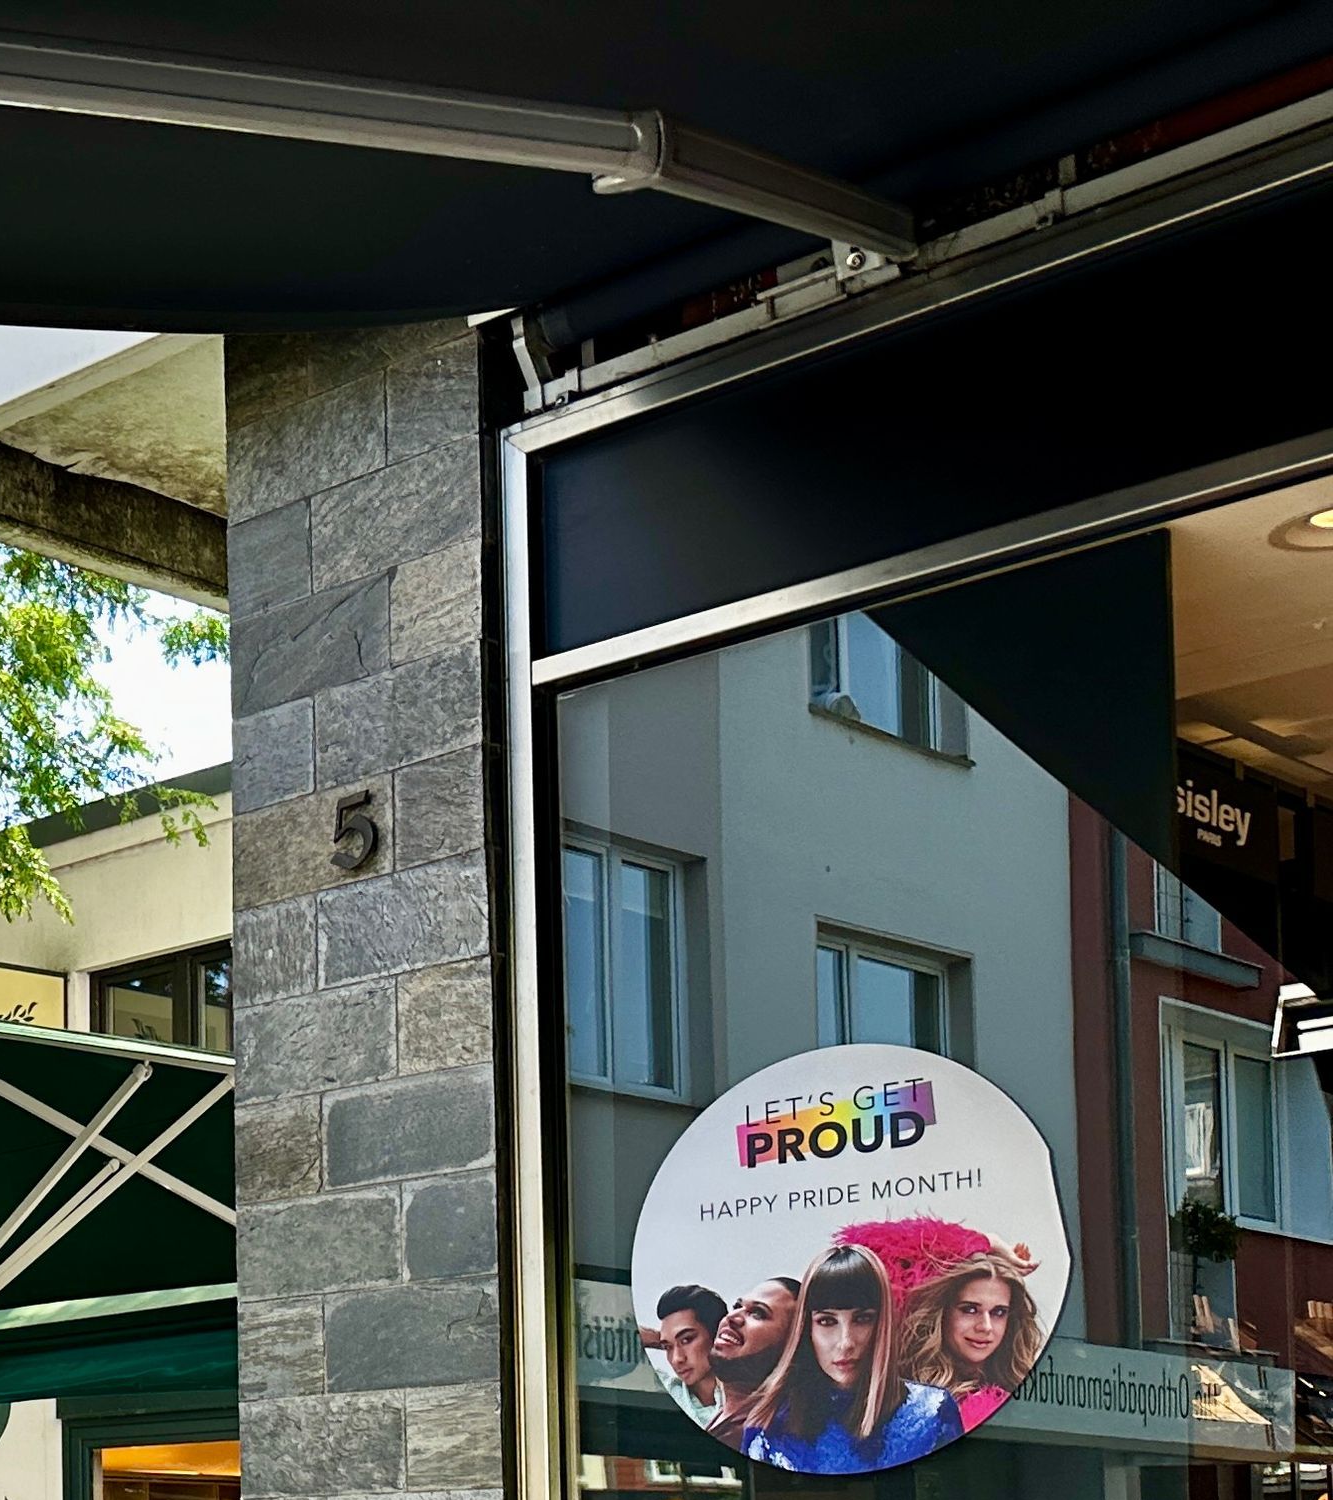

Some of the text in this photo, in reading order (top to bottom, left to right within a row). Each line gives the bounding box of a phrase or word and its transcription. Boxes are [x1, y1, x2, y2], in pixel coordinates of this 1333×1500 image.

[330, 789, 379, 870] 5
[745, 1077, 925, 1127] LET'S GET
[746, 1110, 926, 1169] PROUD
[700, 1167, 983, 1222] HAPPY PRIDE MONTH!
